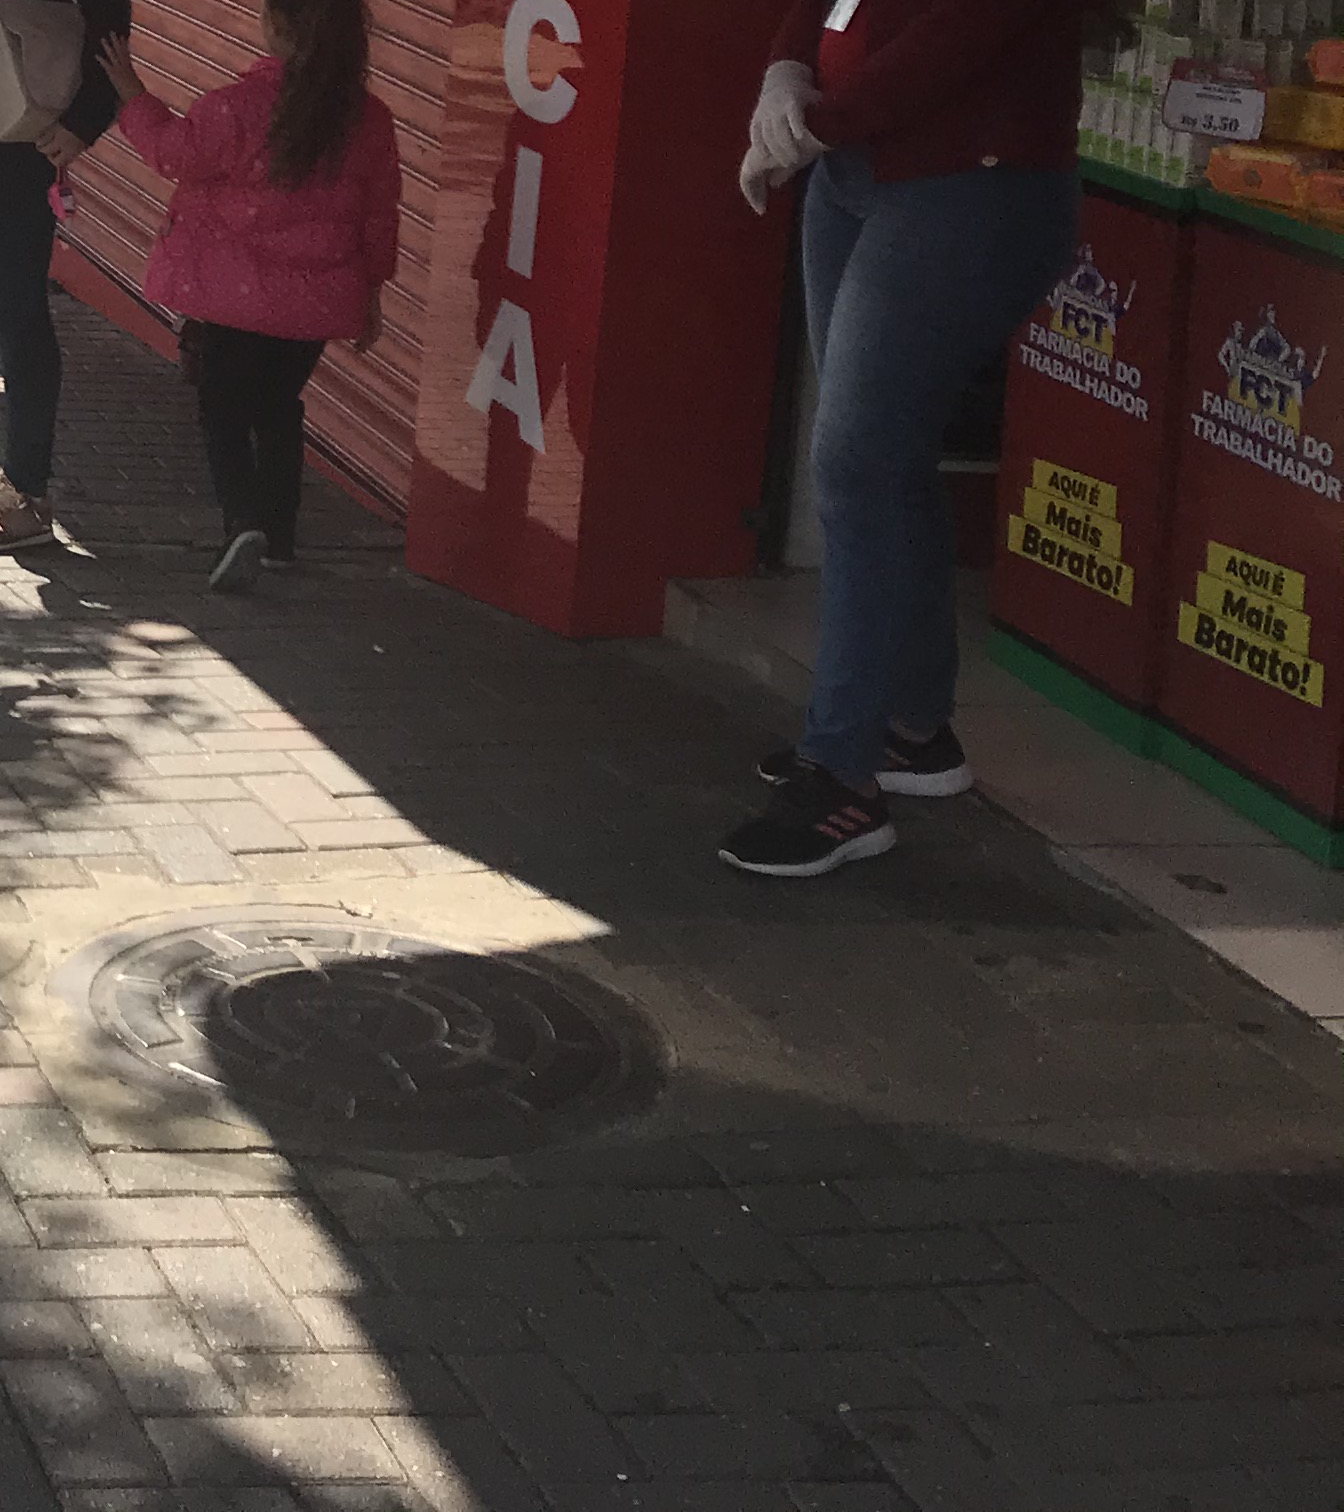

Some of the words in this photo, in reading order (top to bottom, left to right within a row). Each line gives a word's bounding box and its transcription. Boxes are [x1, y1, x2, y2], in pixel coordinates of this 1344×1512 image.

[1061, 301, 1108, 344] FCT
[1019, 342, 1149, 422] TRABALHADOR
[1115, 360, 1141, 390] DO
[1239, 366, 1293, 414] FCT
[1190, 413, 1344, 503] TRABALHADOR
[1302, 434, 1335, 467] DO
[1047, 471, 1088, 501] AQUI
[1089, 482, 1101, 506] É
[1045, 500, 1103, 548] Mais
[1022, 522, 1124, 597] Barato!
[1225, 555, 1271, 590] AQUI
[1272, 569, 1285, 597] É
[1222, 589, 1288, 642] Mais
[1194, 612, 1312, 697] Barato!
